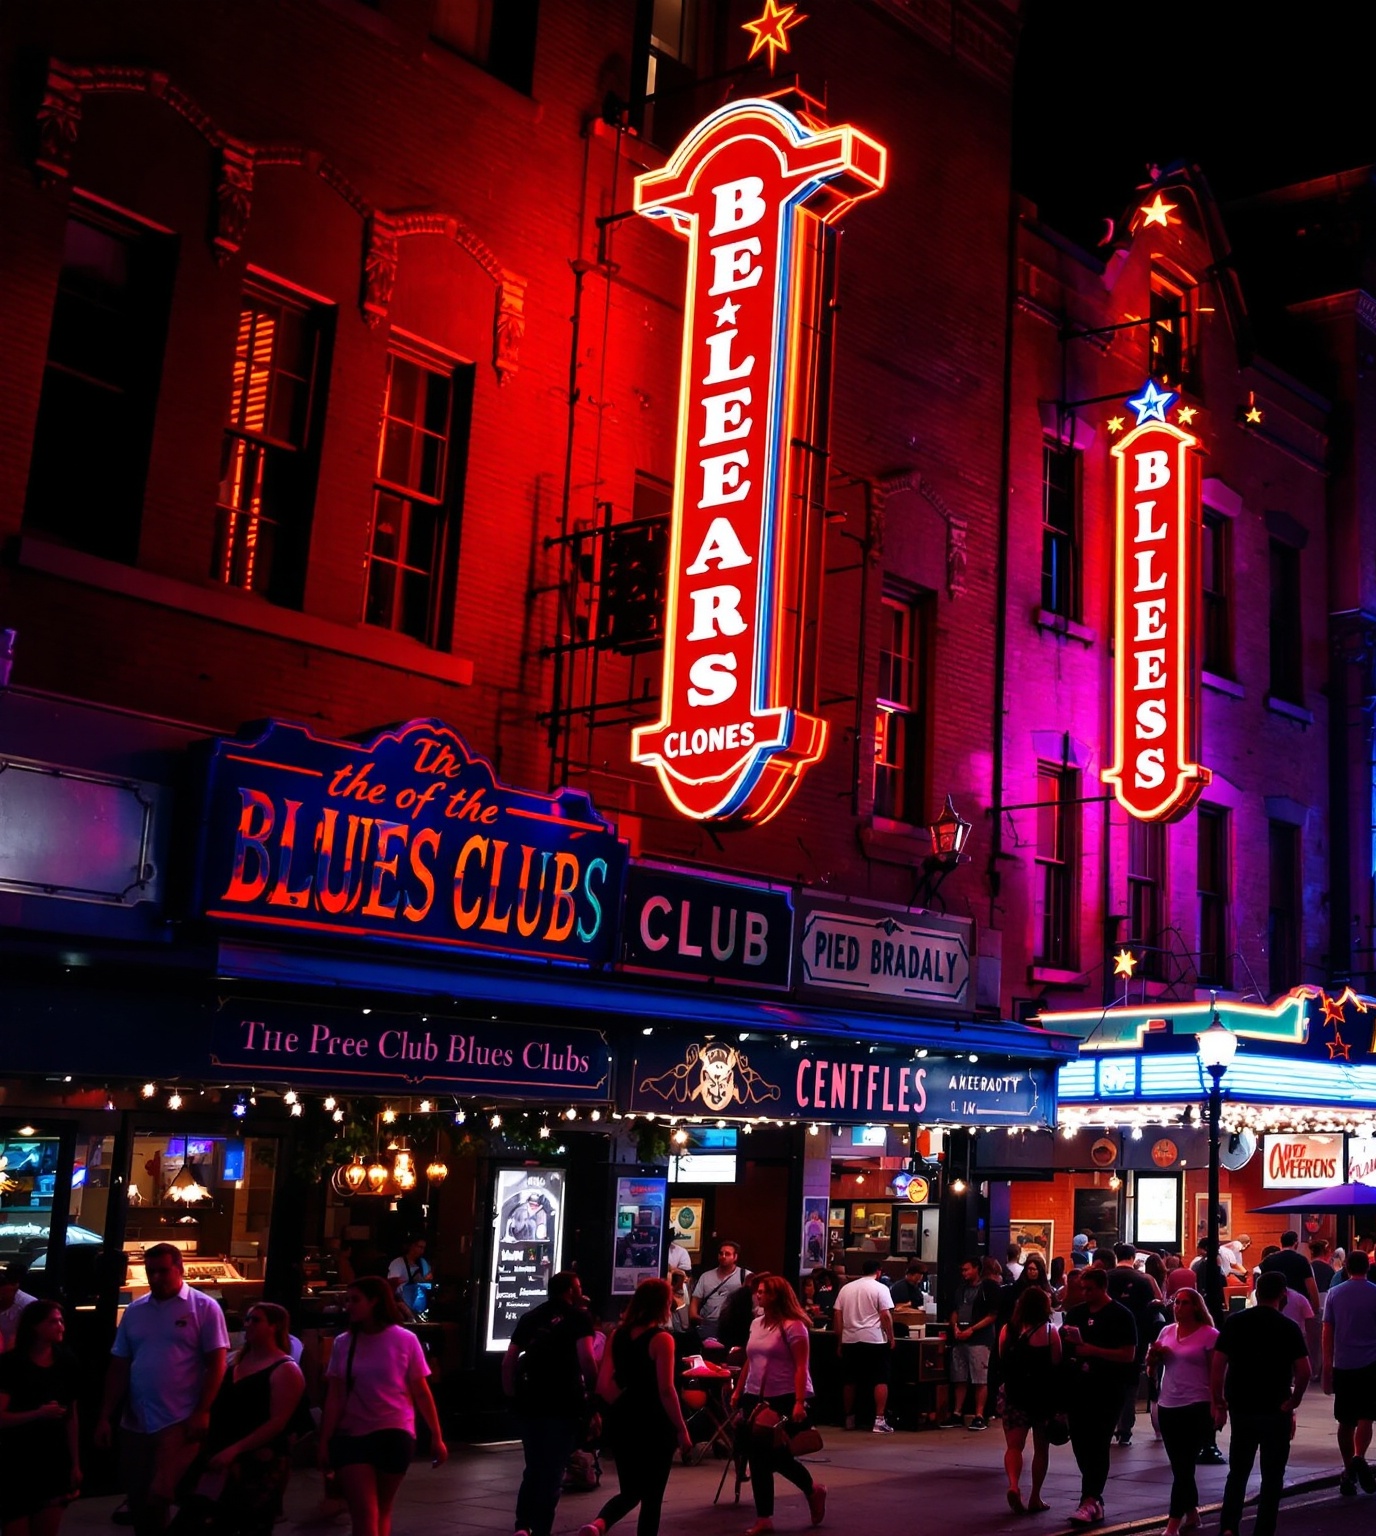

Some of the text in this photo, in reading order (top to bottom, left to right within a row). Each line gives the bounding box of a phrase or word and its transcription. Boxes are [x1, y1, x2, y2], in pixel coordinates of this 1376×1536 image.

[664, 723, 754, 758] CLONES
[327, 762, 499, 825] the of the
[220, 785, 608, 943] BLUES CLUBS
[640, 895, 768, 966] CLUB
[815, 931, 957, 984] PIED BRADALY
[378, 1027, 439, 1064] Club
[445, 1033, 513, 1068] Blues
[522, 1039, 590, 1075] Clubs
